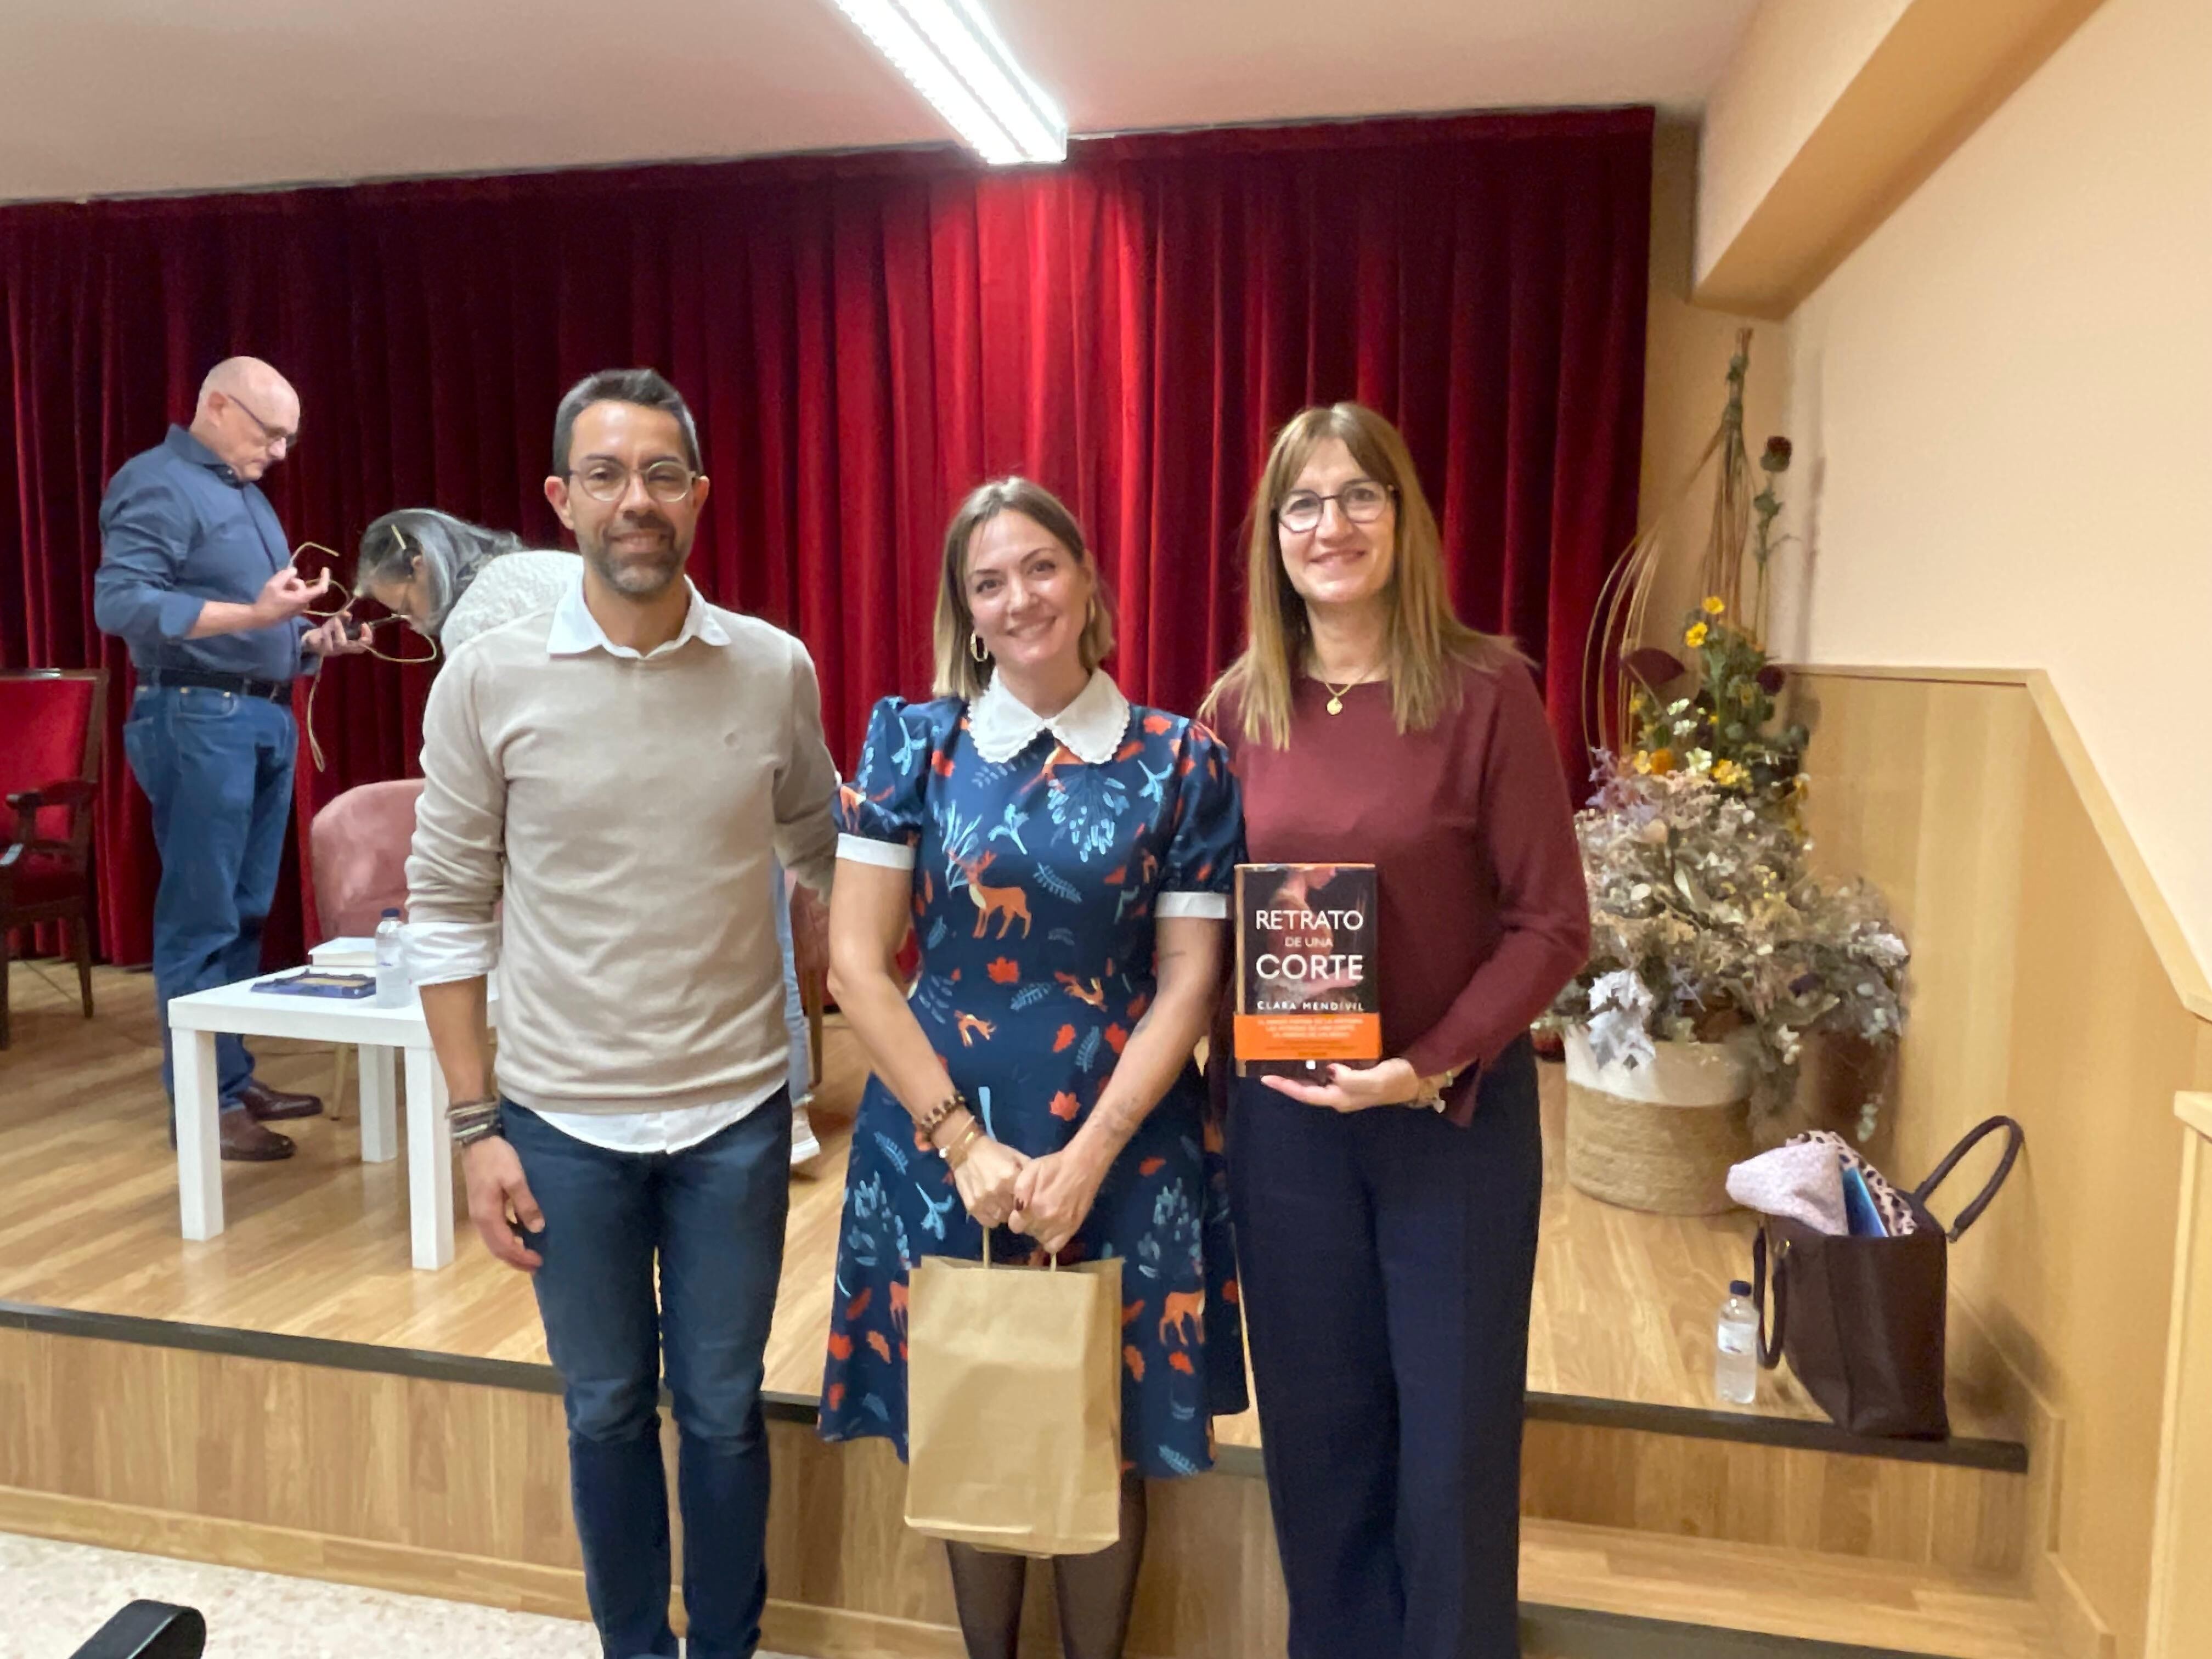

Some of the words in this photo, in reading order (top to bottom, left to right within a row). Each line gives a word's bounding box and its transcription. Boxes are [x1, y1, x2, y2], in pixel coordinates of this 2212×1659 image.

[1256, 910, 1364, 930] RETRATO
[1285, 936, 1302, 947] DE
[1305, 936, 1334, 948] UNA
[1256, 953, 1364, 980] CORTE
[1257, 1001, 1296, 1011] CLARA
